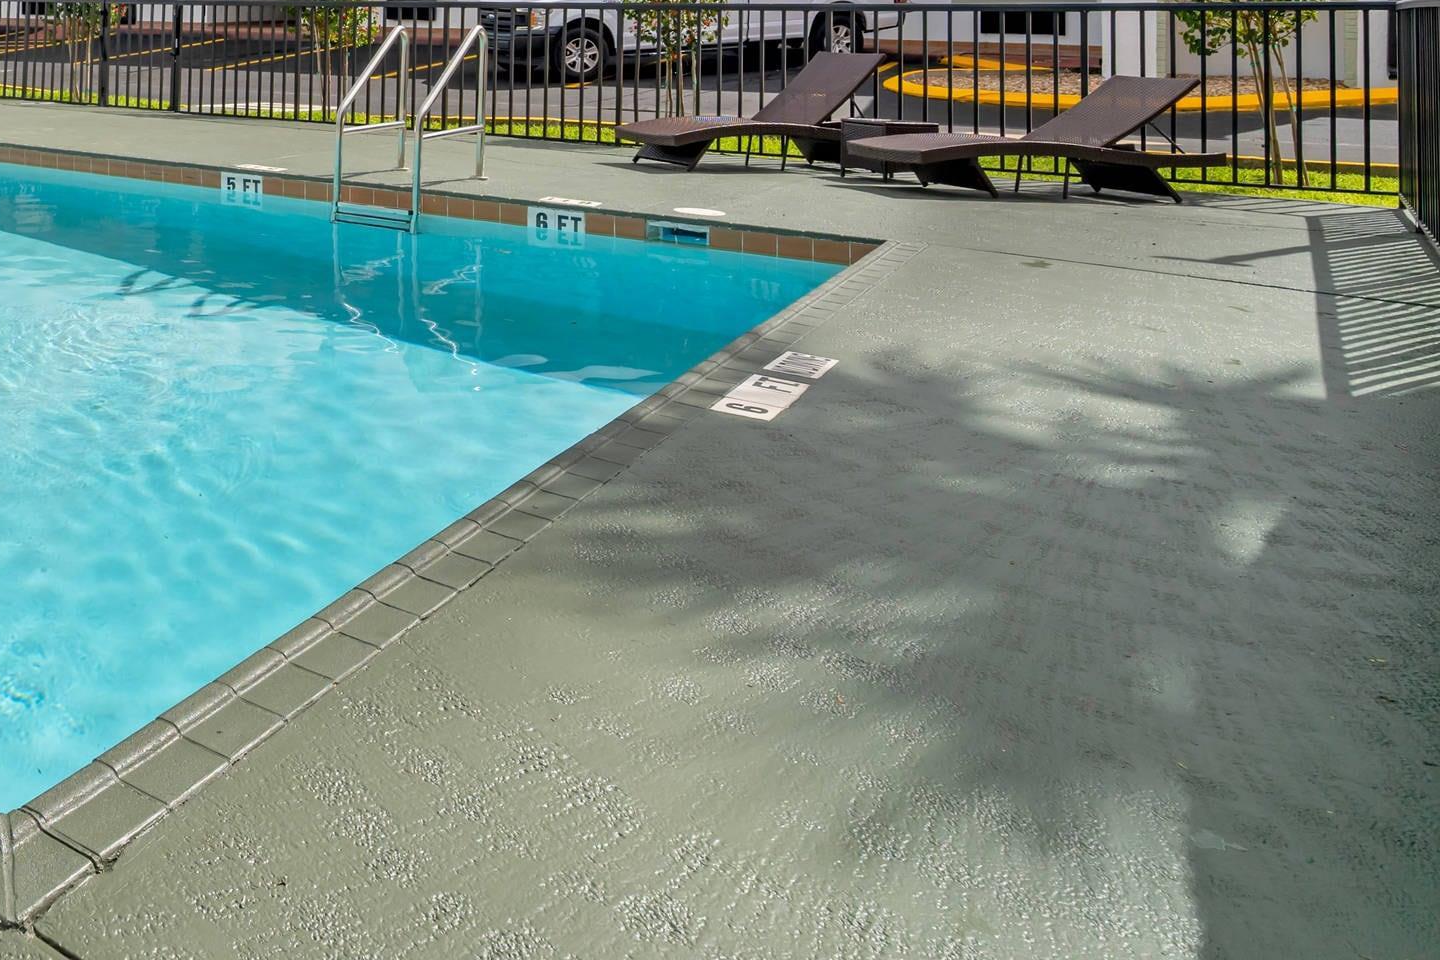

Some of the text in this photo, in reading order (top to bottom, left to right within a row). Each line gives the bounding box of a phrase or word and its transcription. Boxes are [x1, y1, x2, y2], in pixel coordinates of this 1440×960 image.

[226, 177, 261, 193] 5 FT
[536, 212, 582, 233] 6 FT
[725, 402, 769, 415] 6
